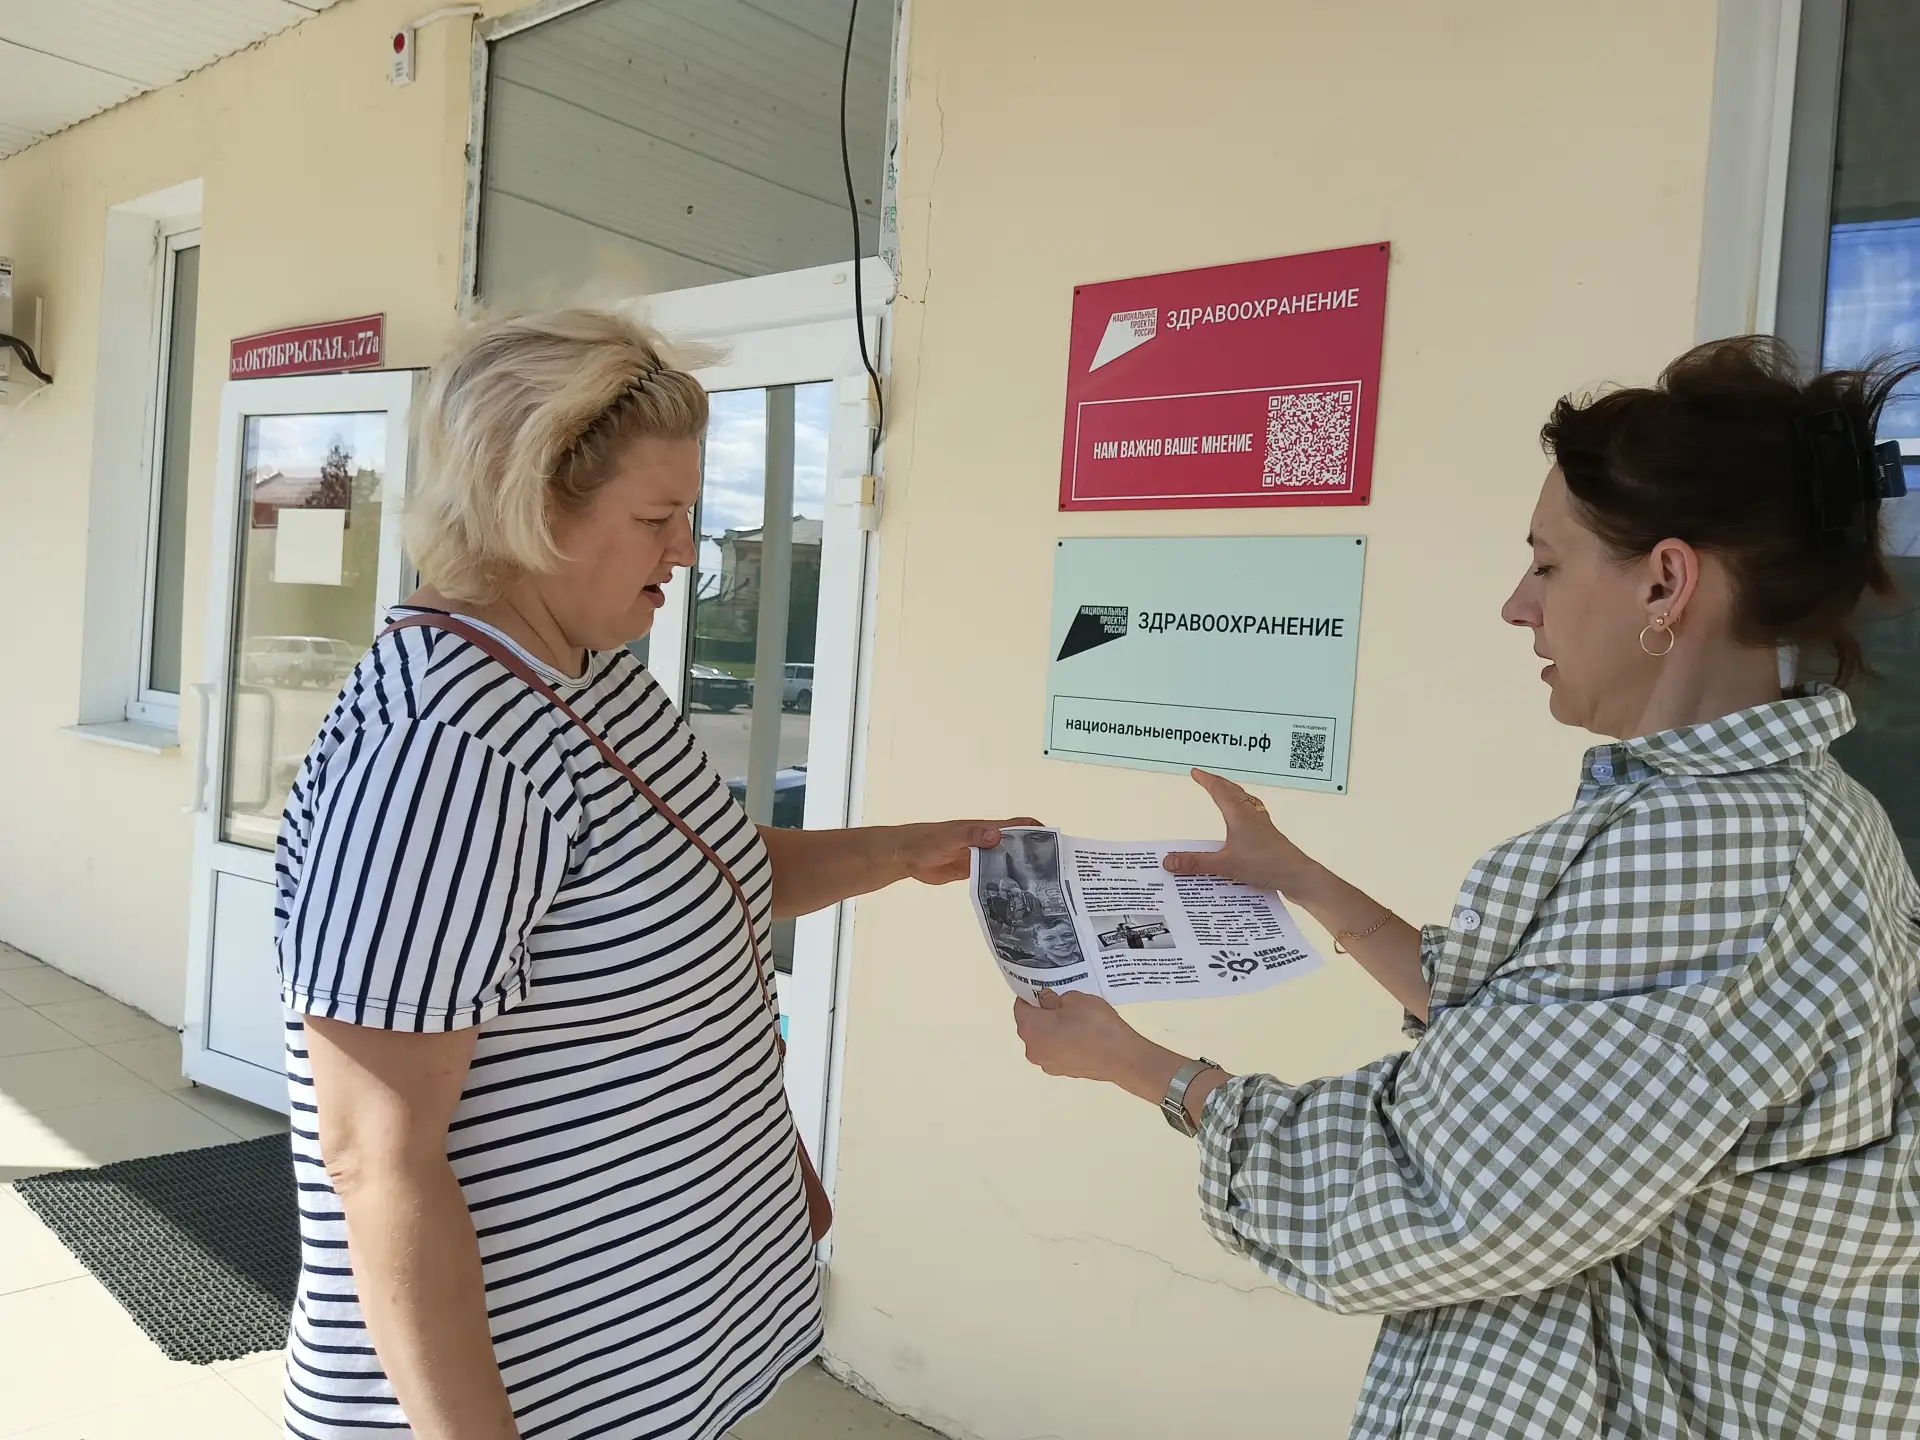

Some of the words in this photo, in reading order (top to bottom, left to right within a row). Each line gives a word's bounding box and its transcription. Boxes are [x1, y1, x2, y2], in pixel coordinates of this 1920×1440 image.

[1112, 309, 1157, 323] НАЦИОНАЛЬНЫЕ
[1166, 288, 1360, 331] ЗДРАВООХРАНЕНИЕ
[1130, 318, 1156, 329] ПРОЕКТЫ
[1133, 327, 1156, 338] РОССИИ
[1093, 441, 1118, 459] НАМ
[1120, 438, 1161, 458] ВАЖНО
[1164, 436, 1199, 456] ВАШЕ
[1201, 433, 1253, 455] МНЕНИЕ
[1080, 606, 1128, 617] НАЦИОНАЛЬНЫЕ
[1100, 615, 1127, 625] ПРОЕКТЫ
[1138, 612, 1344, 638] ЗДРАВООХРАНЕНИЕ
[1104, 624, 1127, 635] РОССИИ
[1066, 716, 1271, 751] национальныепроекты.рф
[1253, 945, 1286, 957] ЦЕНИ
[1262, 949, 1300, 963] СВОЮ
[1264, 954, 1308, 970] ЖИЗНЬ
